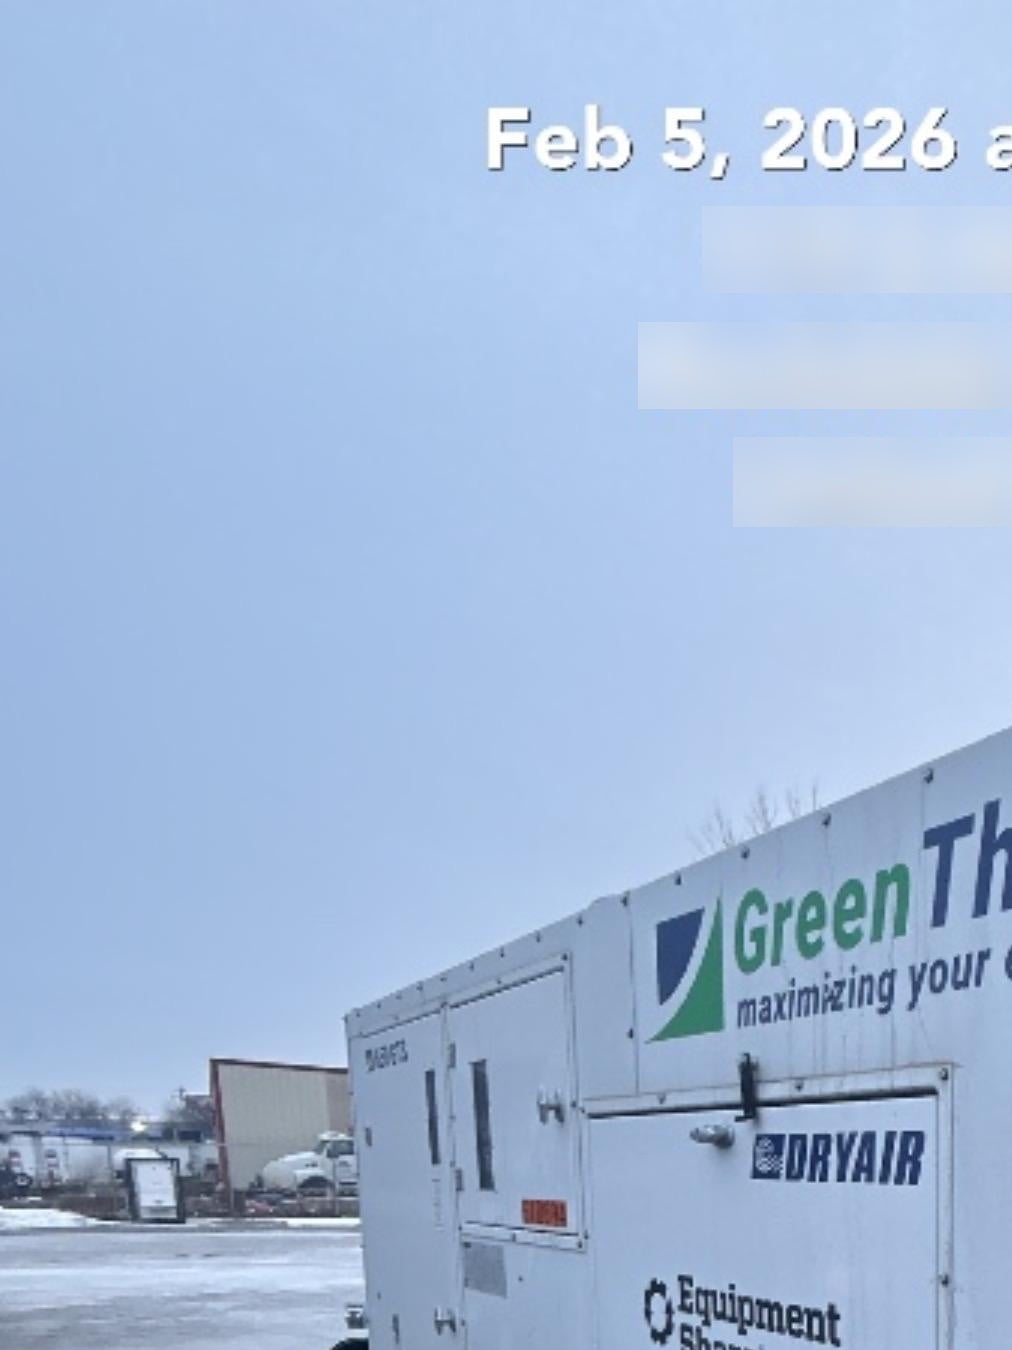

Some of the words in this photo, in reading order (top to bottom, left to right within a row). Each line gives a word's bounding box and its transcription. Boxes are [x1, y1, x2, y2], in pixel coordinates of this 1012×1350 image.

[736, 963, 897, 1029] maximizing
[907, 948, 991, 1010] your
[784, 1130, 926, 1186] DRYAIR
[677, 1274, 841, 1347] Equipment
